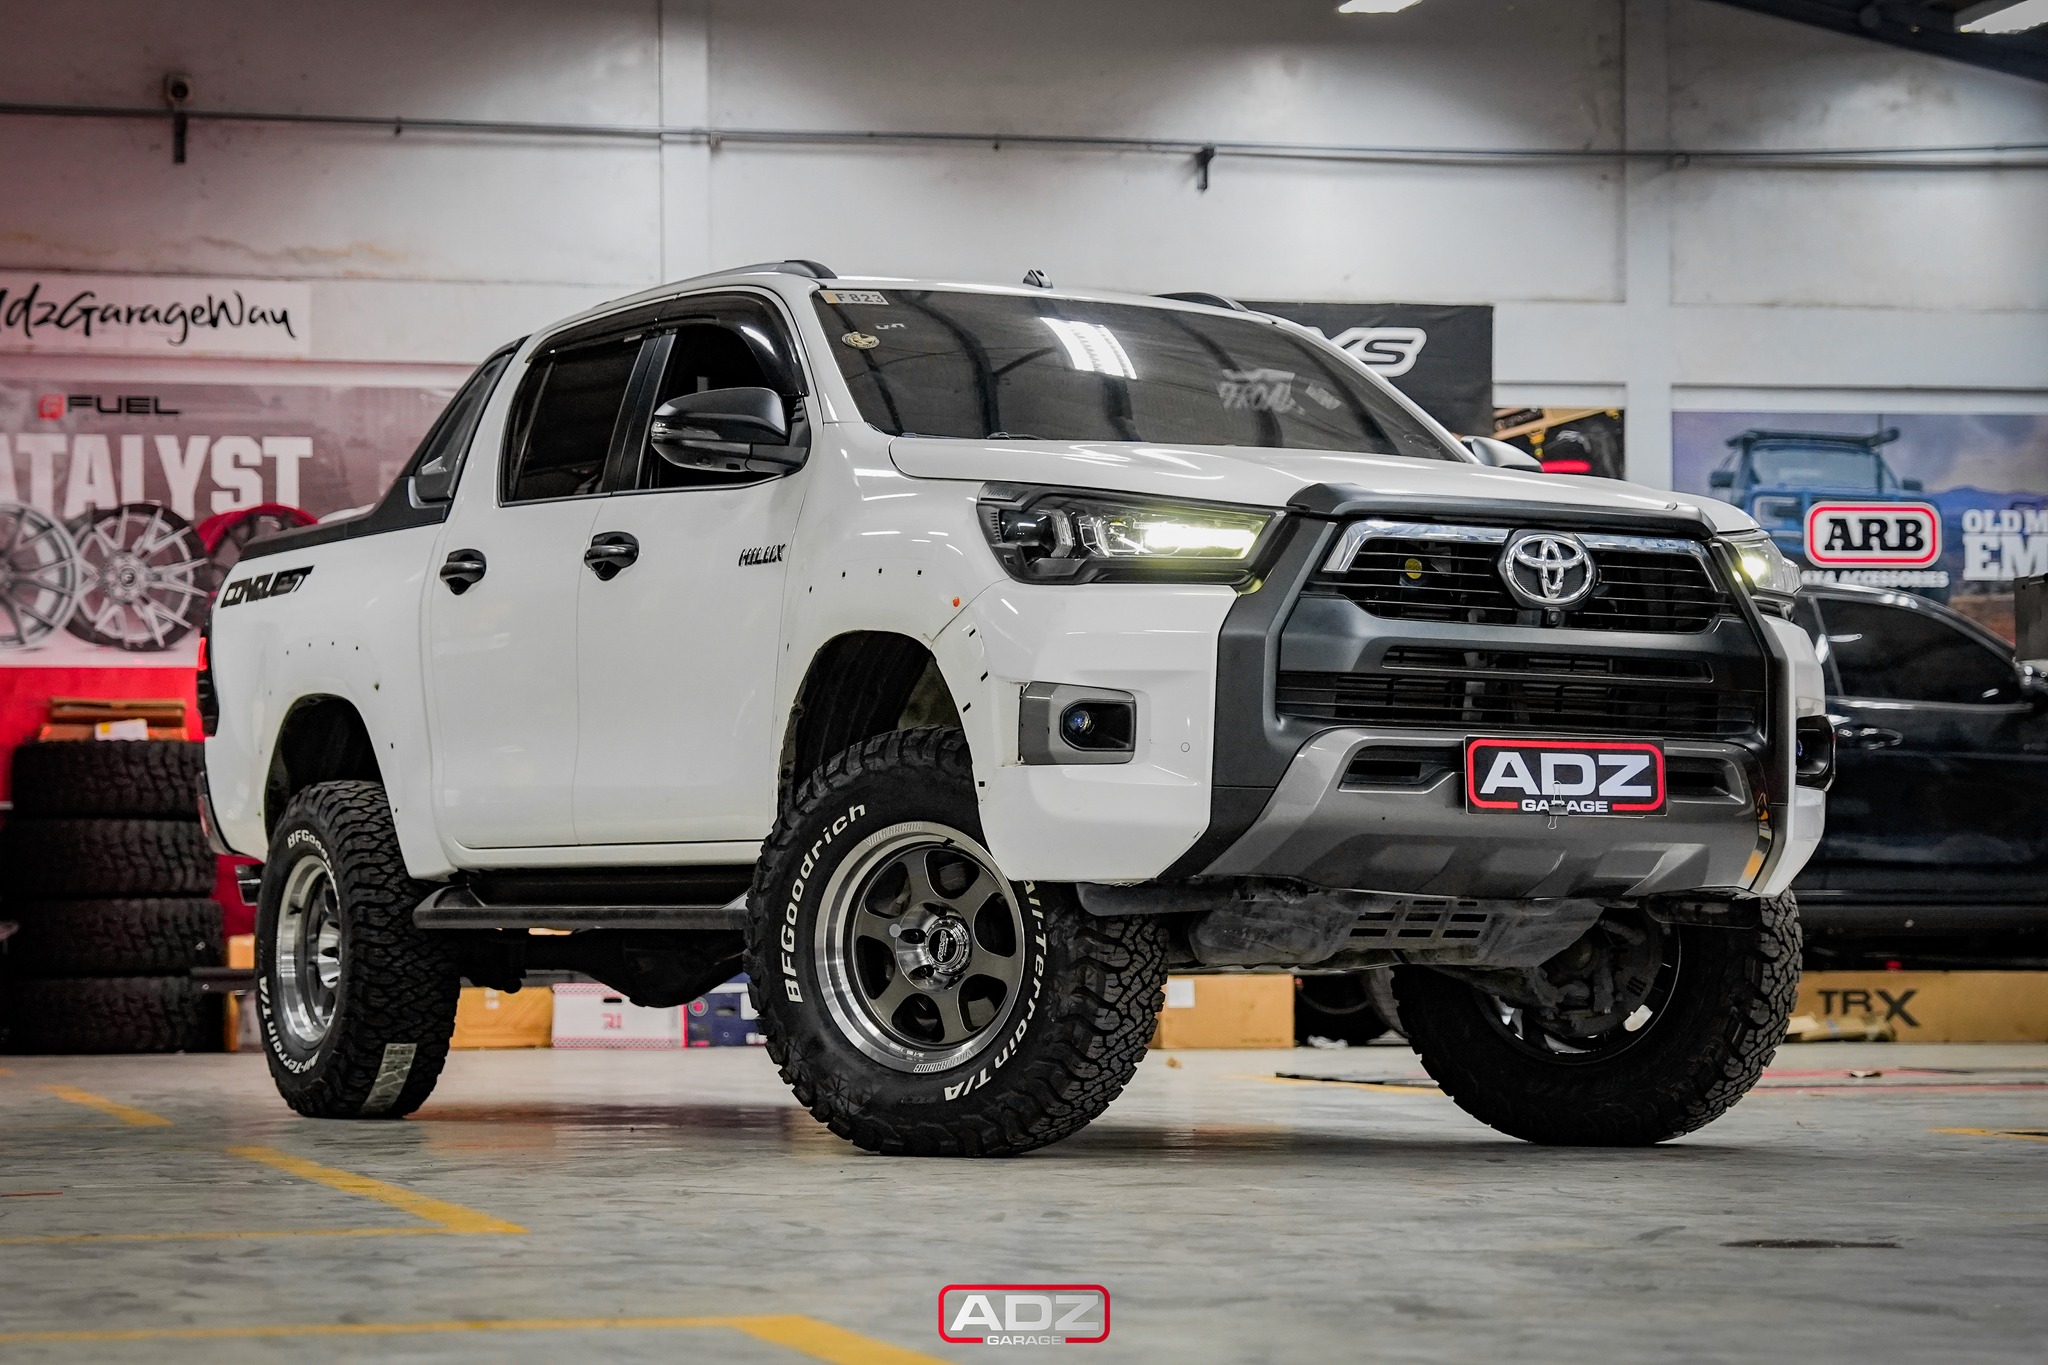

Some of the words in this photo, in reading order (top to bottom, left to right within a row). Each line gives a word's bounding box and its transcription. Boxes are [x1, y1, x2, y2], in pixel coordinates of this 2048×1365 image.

[851, 293, 885, 304] 823
[67, 395, 179, 414] FUEL
[1824, 518, 1924, 551] ARB
[1962, 509, 2023, 533] OLD
[1479, 751, 1652, 797] ADZ
[1521, 799, 1608, 813] GAAGE
[780, 803, 866, 1003] BFGoodrich
[1817, 988, 1920, 1028] TRX
[944, 1067, 992, 1101] T/A
